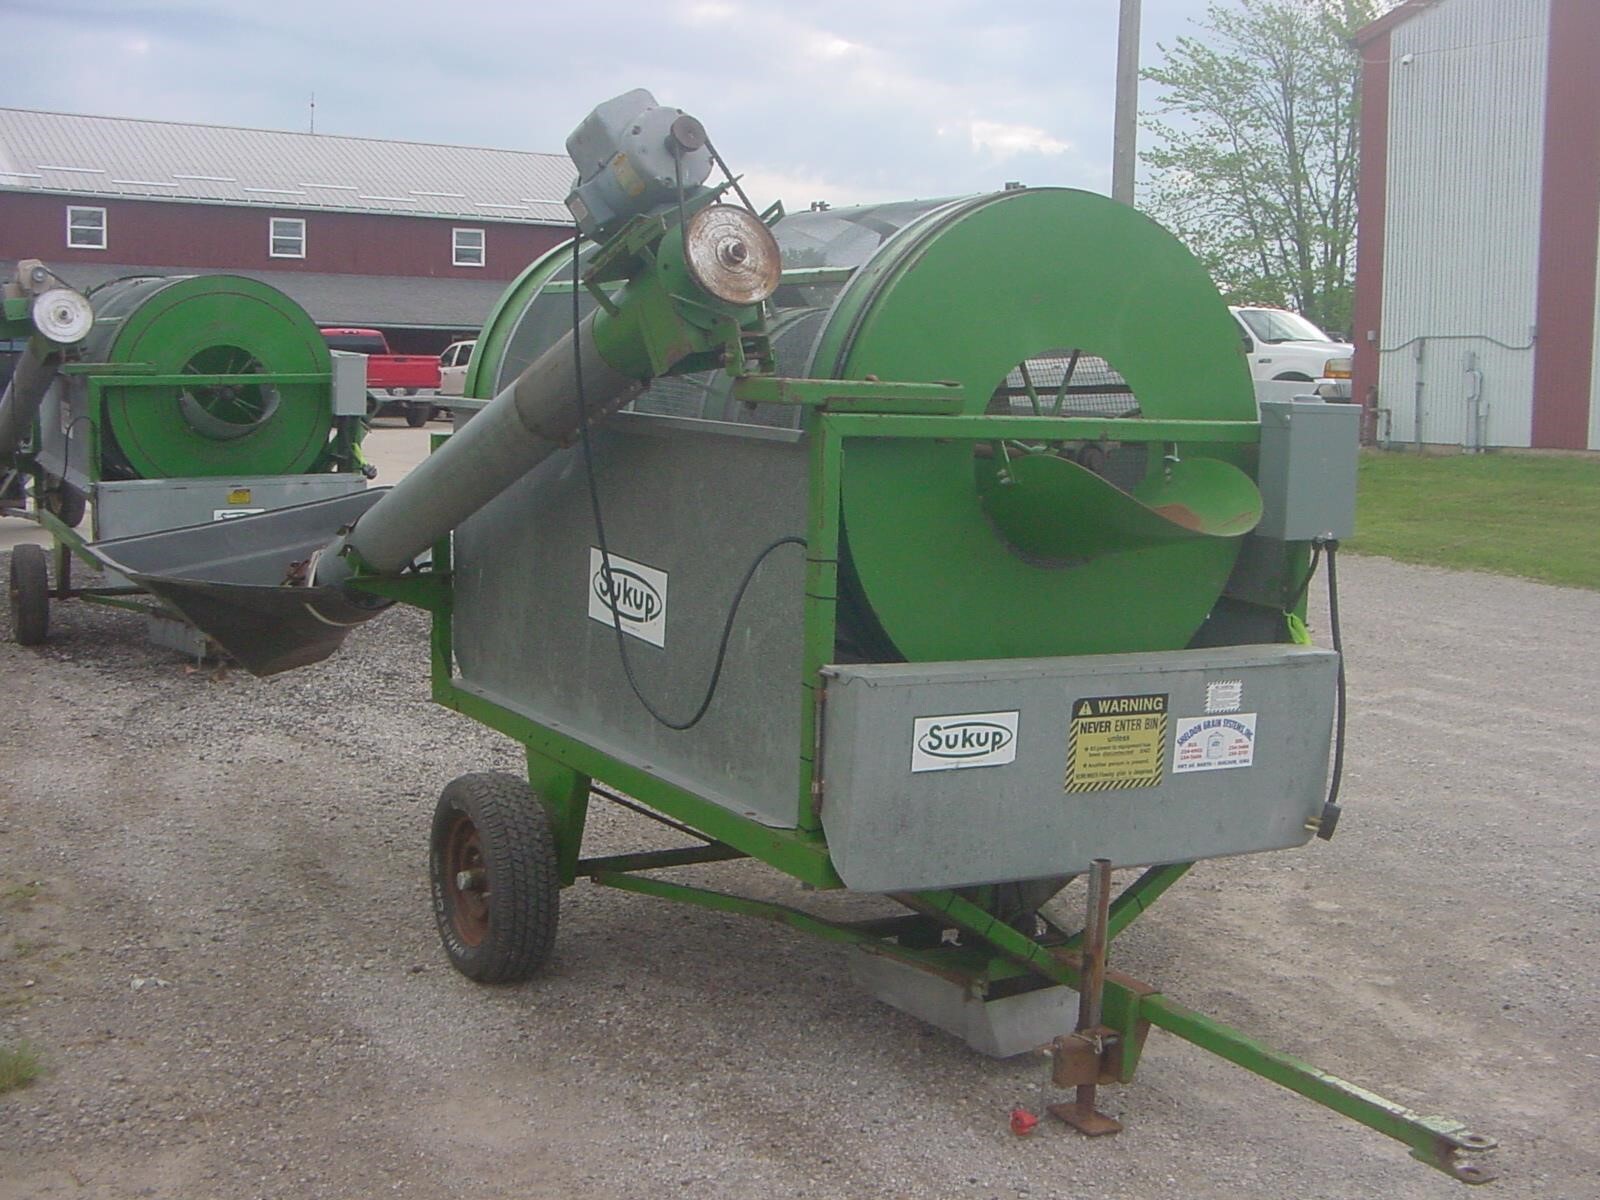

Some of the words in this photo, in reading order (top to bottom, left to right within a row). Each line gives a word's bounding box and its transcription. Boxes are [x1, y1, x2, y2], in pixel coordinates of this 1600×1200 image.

[599, 563, 655, 622] Sukup
[1098, 697, 1164, 714] WARNING
[1080, 720, 1112, 734] NEVER
[1114, 719, 1142, 733] ENTER
[1144, 717, 1159, 730] BIN
[927, 724, 1004, 752] Sukup
